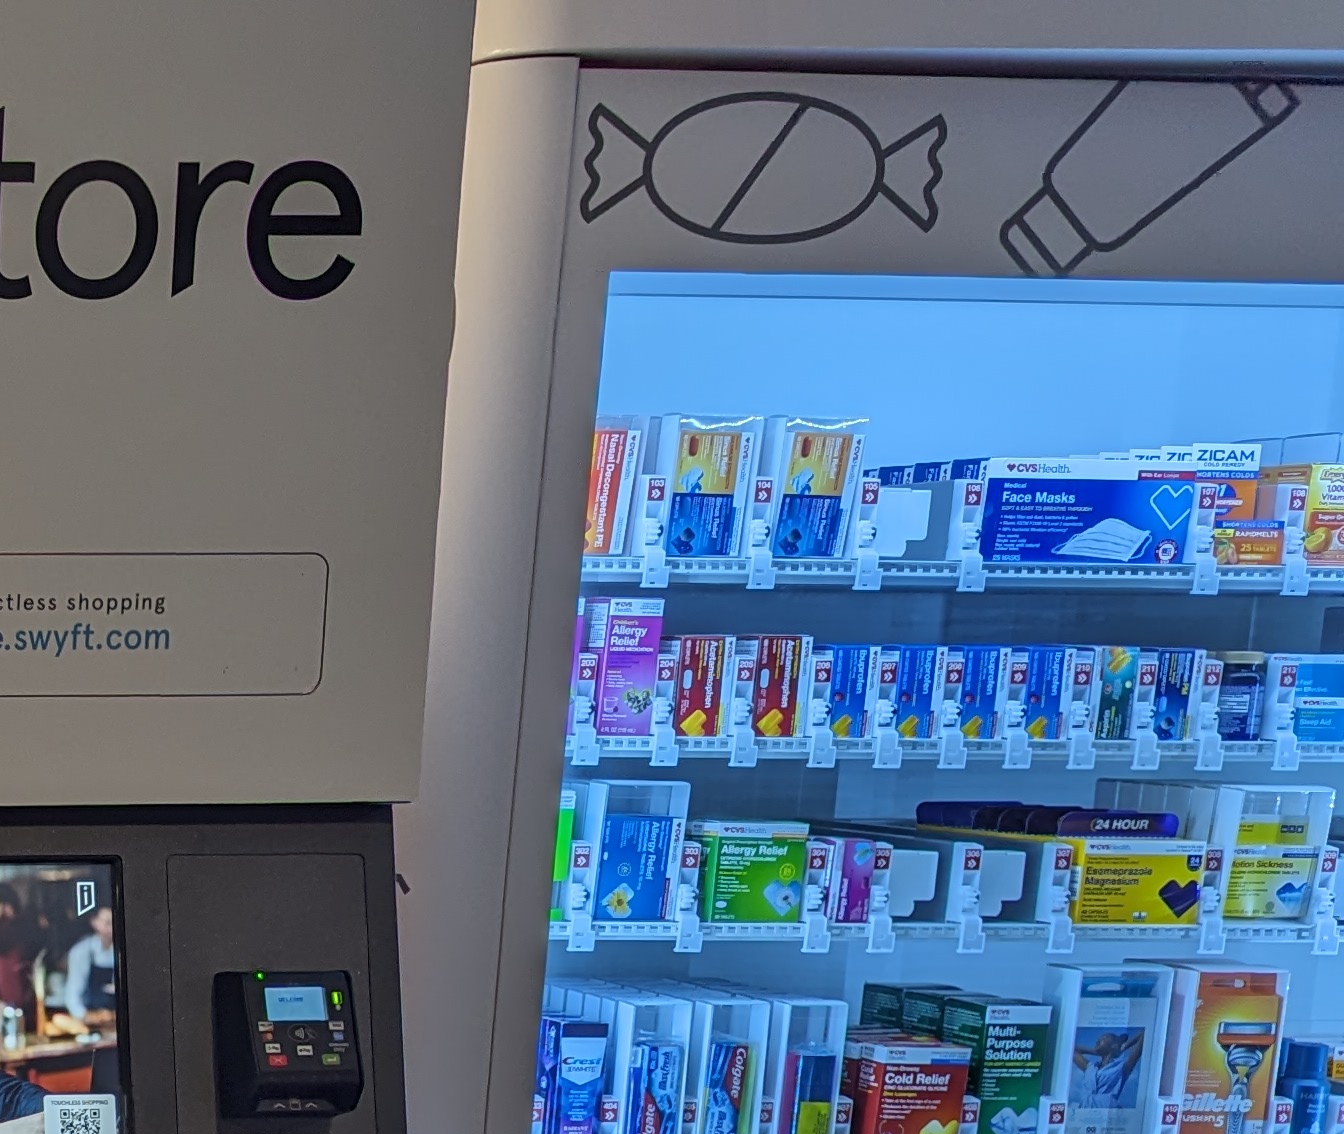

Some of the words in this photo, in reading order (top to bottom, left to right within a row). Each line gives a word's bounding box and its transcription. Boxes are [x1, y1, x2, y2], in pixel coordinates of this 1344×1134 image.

[608, 433, 620, 463] Nasal
[1197, 449, 1255, 462] ZICAM
[756, 480, 771, 488] 104
[864, 482, 879, 490] 105
[596, 461, 615, 533] Decongestant
[1002, 491, 1032, 503] Face
[1035, 492, 1076, 504] Masks
[1292, 489, 1306, 497] 108
[66, 592, 165, 615] shopping
[611, 625, 648, 638] Allergy
[610, 636, 640, 646] Relief
[856, 649, 868, 695] Ibuprofen
[882, 662, 896, 670] 207
[921, 649, 933, 695] Ibuprofen
[704, 640, 718, 709] Acetaminophen
[781, 640, 796, 708] Acetaminophen
[985, 650, 999, 696] Ibuprofen
[1050, 651, 1064, 697] Ibuprofen
[1094, 818, 1112, 830] 24
[1112, 818, 1150, 830] HOUR
[647, 820, 660, 854] Allergy
[575, 847, 590, 855] 302
[685, 847, 699, 855] 303
[720, 844, 757, 857] Allergy
[759, 844, 789, 855] Relief
[812, 848, 825, 856] 304
[645, 854, 656, 881] Relief
[1256, 860, 1295, 869] Sickness
[1085, 866, 1153, 877] Esomeprazole
[1084, 876, 1140, 887] Magnesium
[987, 1025, 1022, 1037] Multi-
[985, 1037, 1035, 1050] Purpose
[561, 1056, 602, 1066] Crest
[984, 1050, 1032, 1061] Solution
[731, 1047, 747, 1099] Colgate
[884, 1072, 914, 1085] Cold
[915, 1073, 951, 1085] Relief
[603, 1103, 618, 1111] 404
[1164, 1105, 1178, 1113] 410
